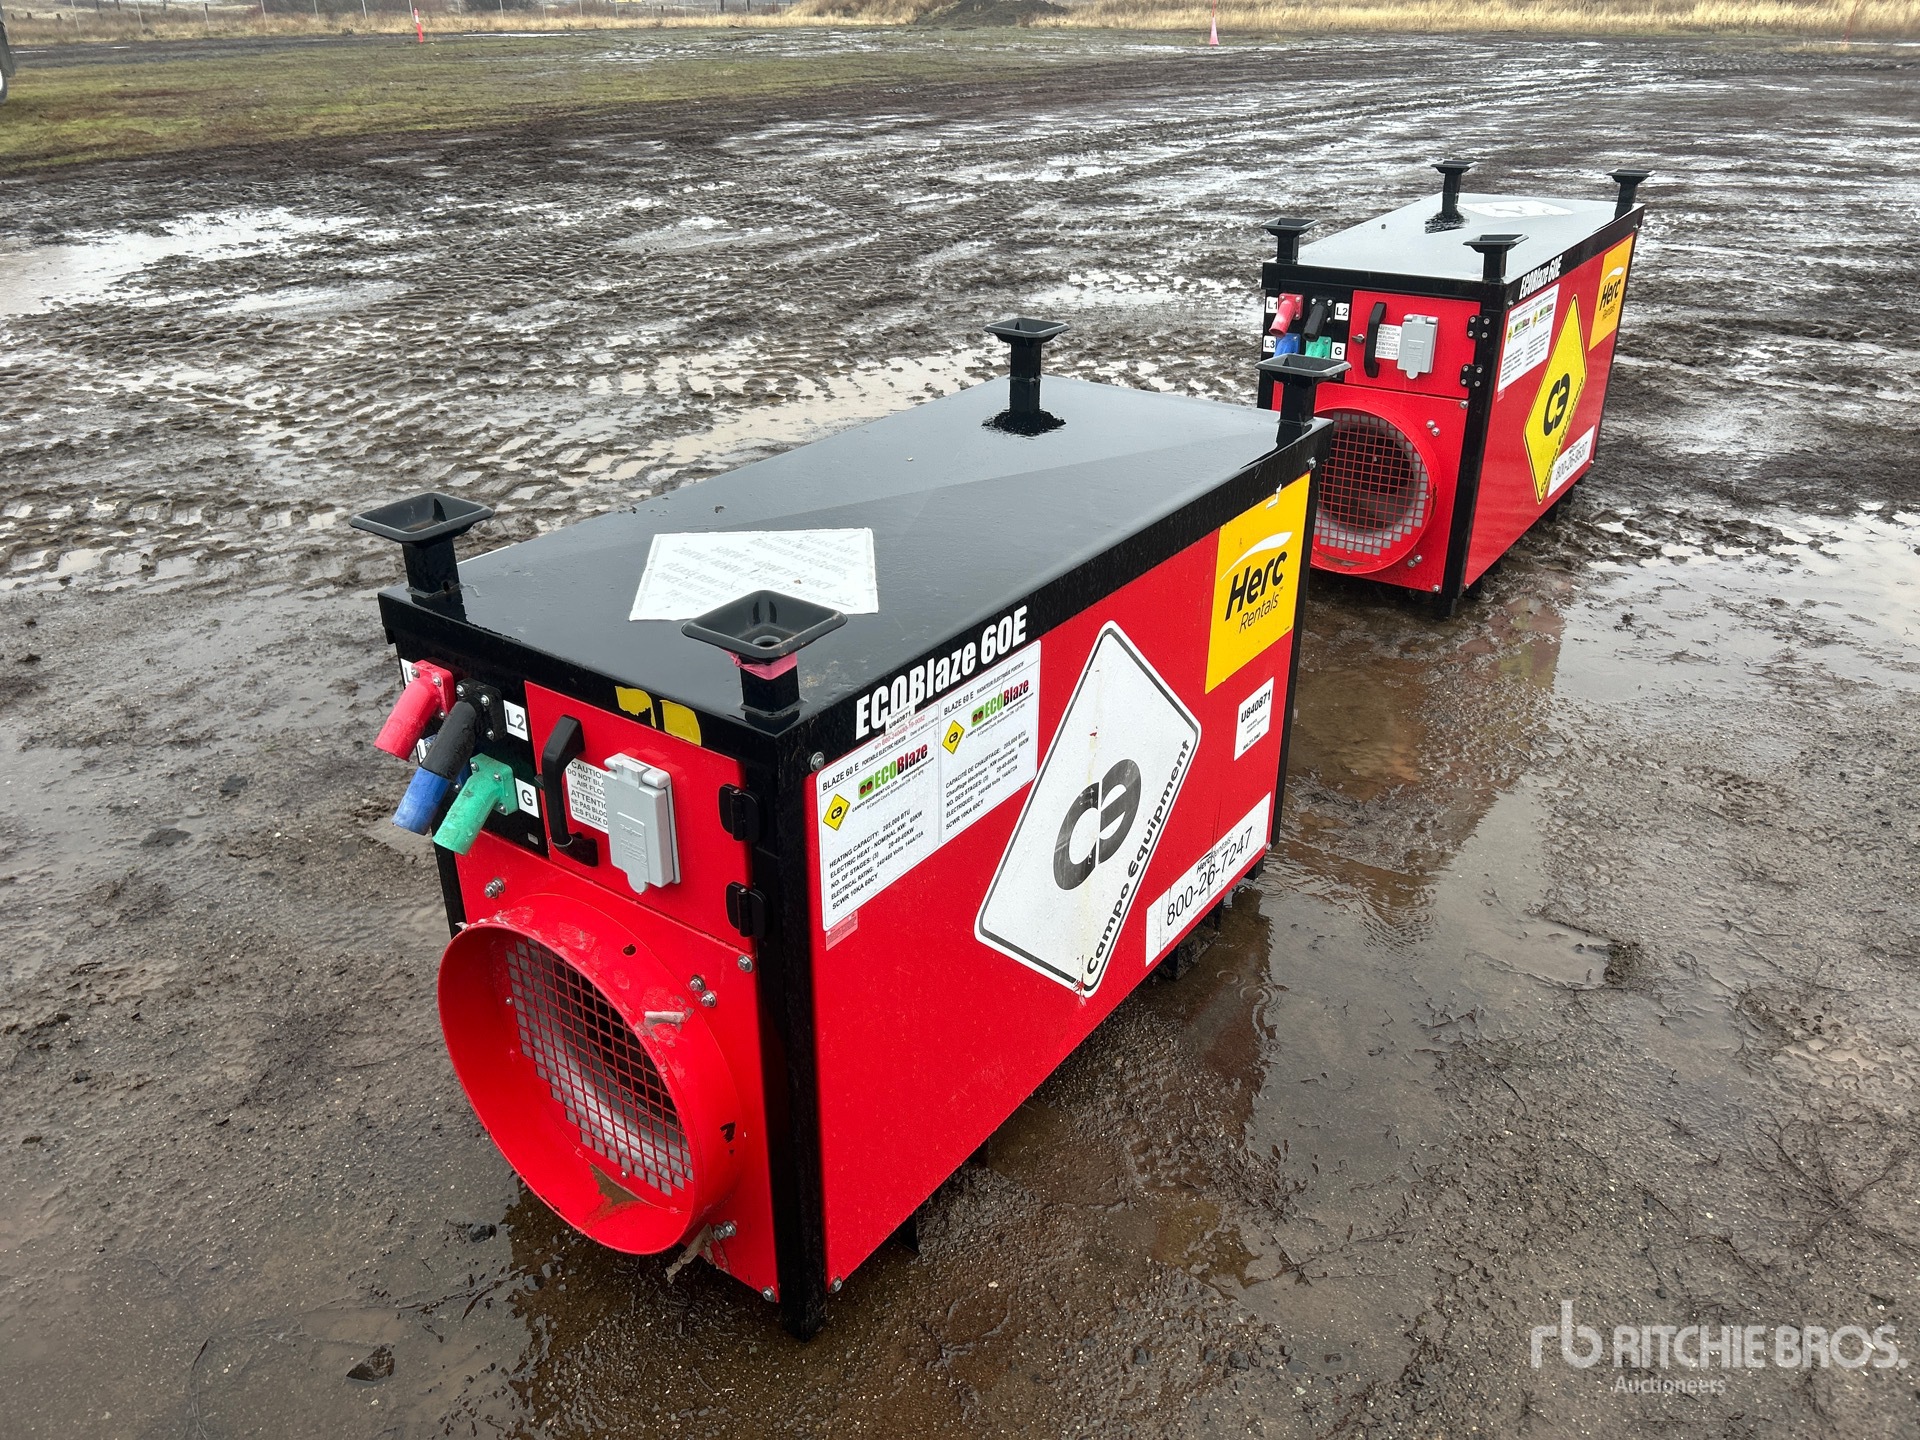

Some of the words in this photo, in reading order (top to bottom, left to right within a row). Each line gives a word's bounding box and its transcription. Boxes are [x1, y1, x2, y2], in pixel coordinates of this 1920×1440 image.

[1268, 301, 1278, 309] L1
[1599, 279, 1621, 311] Herc
[1336, 307, 1348, 317] L2
[1264, 340, 1276, 348] L3
[1334, 346, 1342, 356] G
[1225, 552, 1287, 622] Herc
[1239, 592, 1279, 634] Rentals
[856, 642, 976, 740] ECOBlaze
[981, 605, 1027, 664] 60E
[944, 698, 961, 715] BLAZE
[970, 691, 973, 699] E
[985, 680, 1028, 717] ECOBlaze
[506, 710, 526, 732] L2
[567, 768, 577, 776] DO
[578, 773, 591, 782] NOT
[822, 771, 844, 791] BLAZE
[845, 766, 853, 776] 60
[854, 762, 859, 771] E
[875, 745, 927, 788] ECOBlaze
[521, 789, 533, 807] G
[576, 780, 588, 789] AIR
[572, 806, 583, 815] LES
[585, 810, 602, 824] FLUX
[580, 801, 591, 810] PAS
[829, 848, 852, 868] HEATING
[853, 831, 878, 851] CAPACITY:
[900, 809, 910, 819] BTU
[830, 856, 855, 878] ELECTRIC
[856, 846, 870, 860] HEAT
[874, 830, 896, 847] NOMINAL
[1086, 882, 1130, 975] Campo
[1128, 739, 1190, 878] Equipment
[830, 879, 840, 888] NO.
[841, 872, 848, 881] OF
[850, 857, 870, 875] STAGES:
[831, 879, 856, 899] ELECTRICAL
[857, 866, 872, 880] RATING:
[1167, 826, 1253, 926] 800-26-7247
[832, 893, 849, 909] SCWR
[850, 883, 864, 896] 10KA
